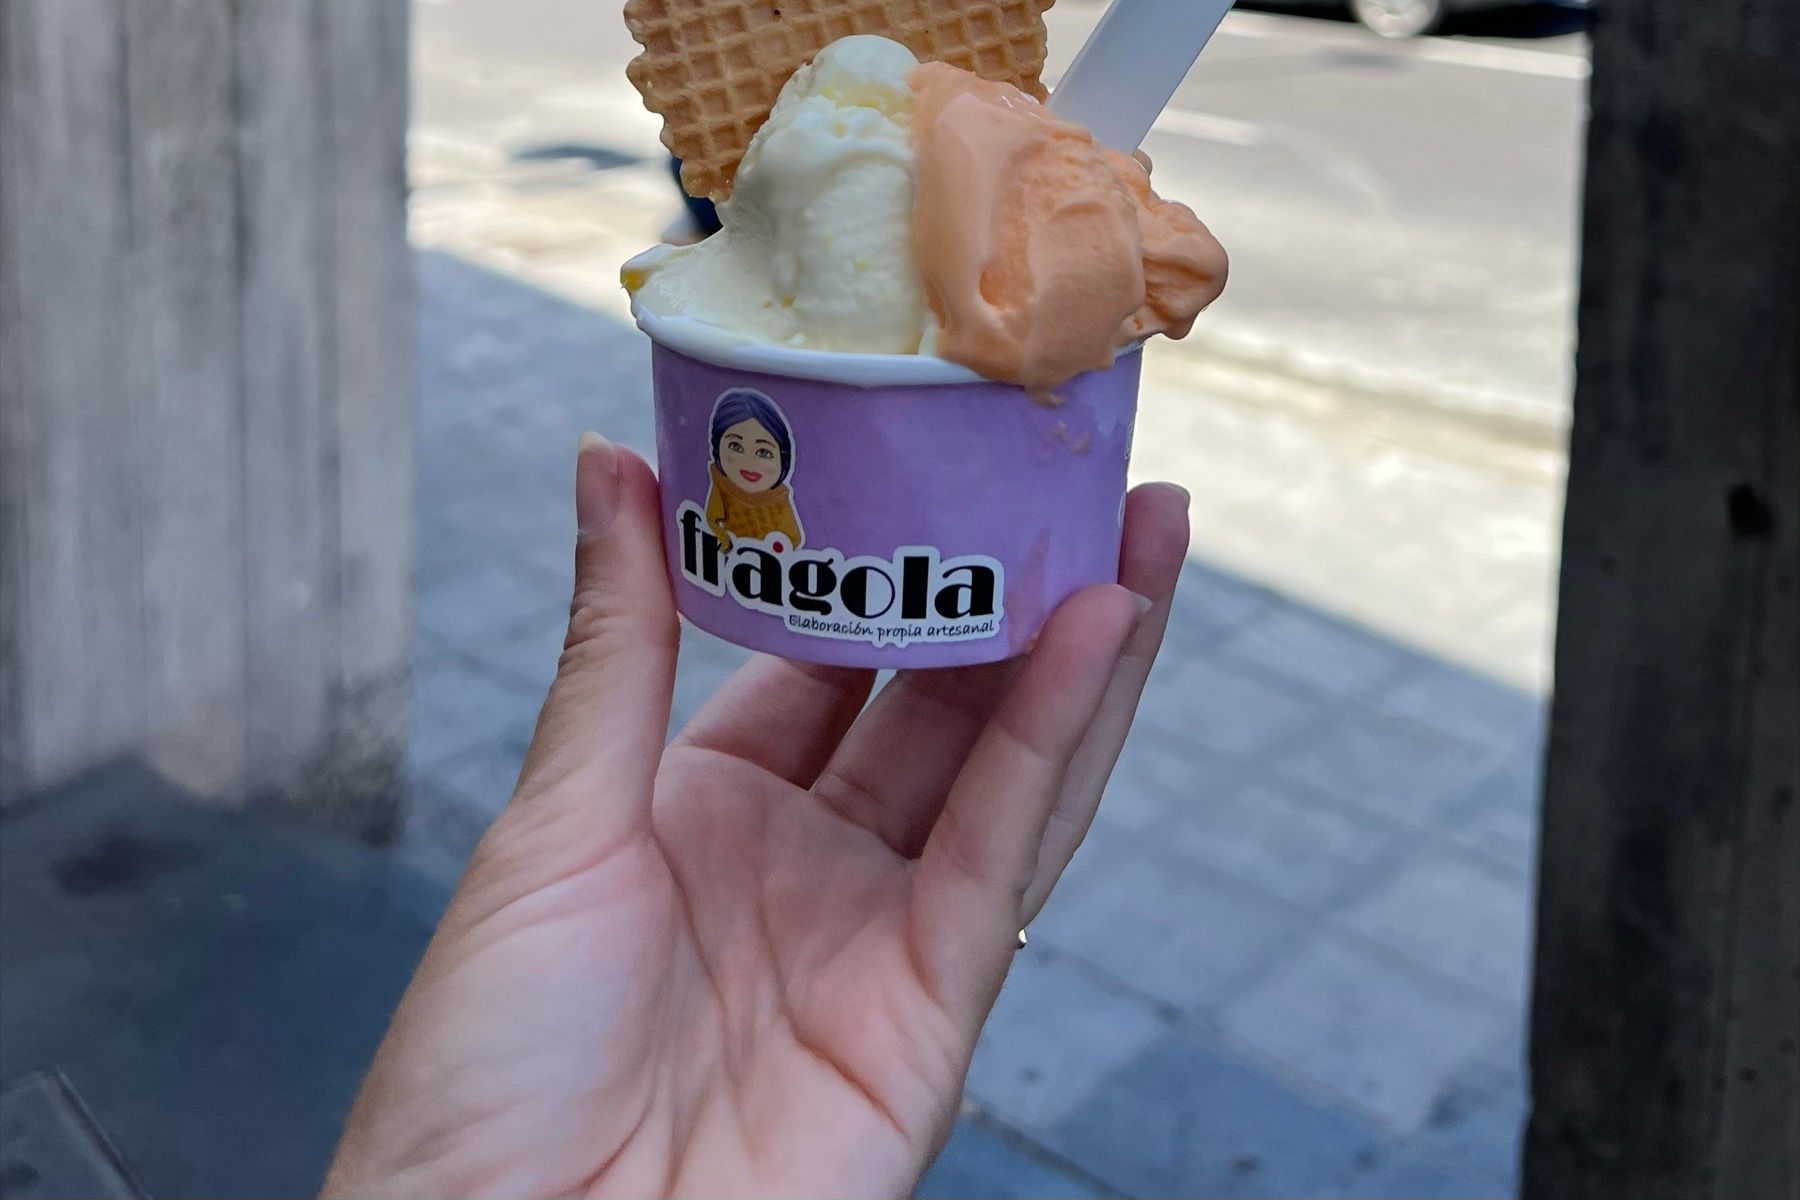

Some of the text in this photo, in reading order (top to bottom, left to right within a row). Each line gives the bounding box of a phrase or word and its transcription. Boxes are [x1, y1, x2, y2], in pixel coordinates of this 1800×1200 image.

[680, 509, 995, 619] fragola
[788, 614, 995, 641] Elaboración propia artesanal
